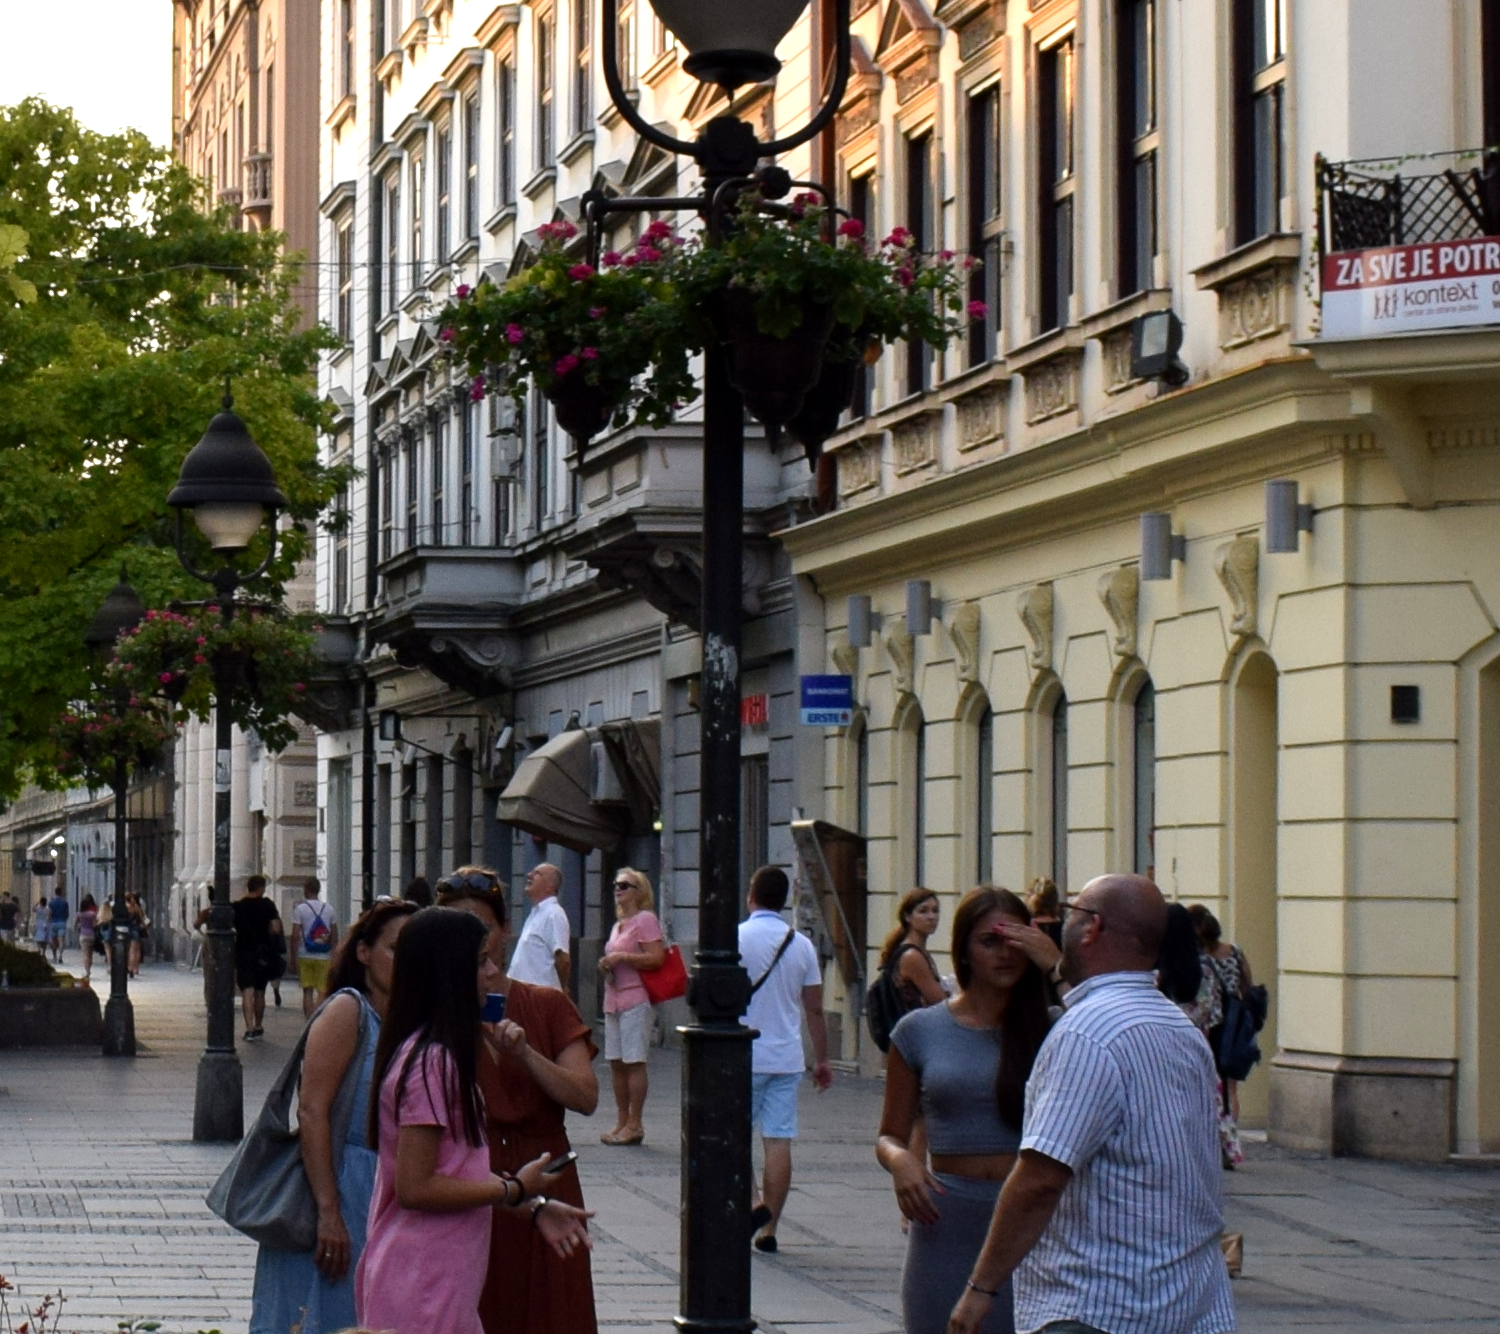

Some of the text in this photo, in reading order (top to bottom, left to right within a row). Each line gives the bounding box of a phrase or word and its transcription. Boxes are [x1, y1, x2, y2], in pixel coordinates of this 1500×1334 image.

[1336, 259, 1364, 286] ZA
[1368, 252, 1407, 282] SVE
[1410, 249, 1434, 278] JE
[1403, 282, 1480, 307] kontext
[807, 713, 841, 723] ERSTE
